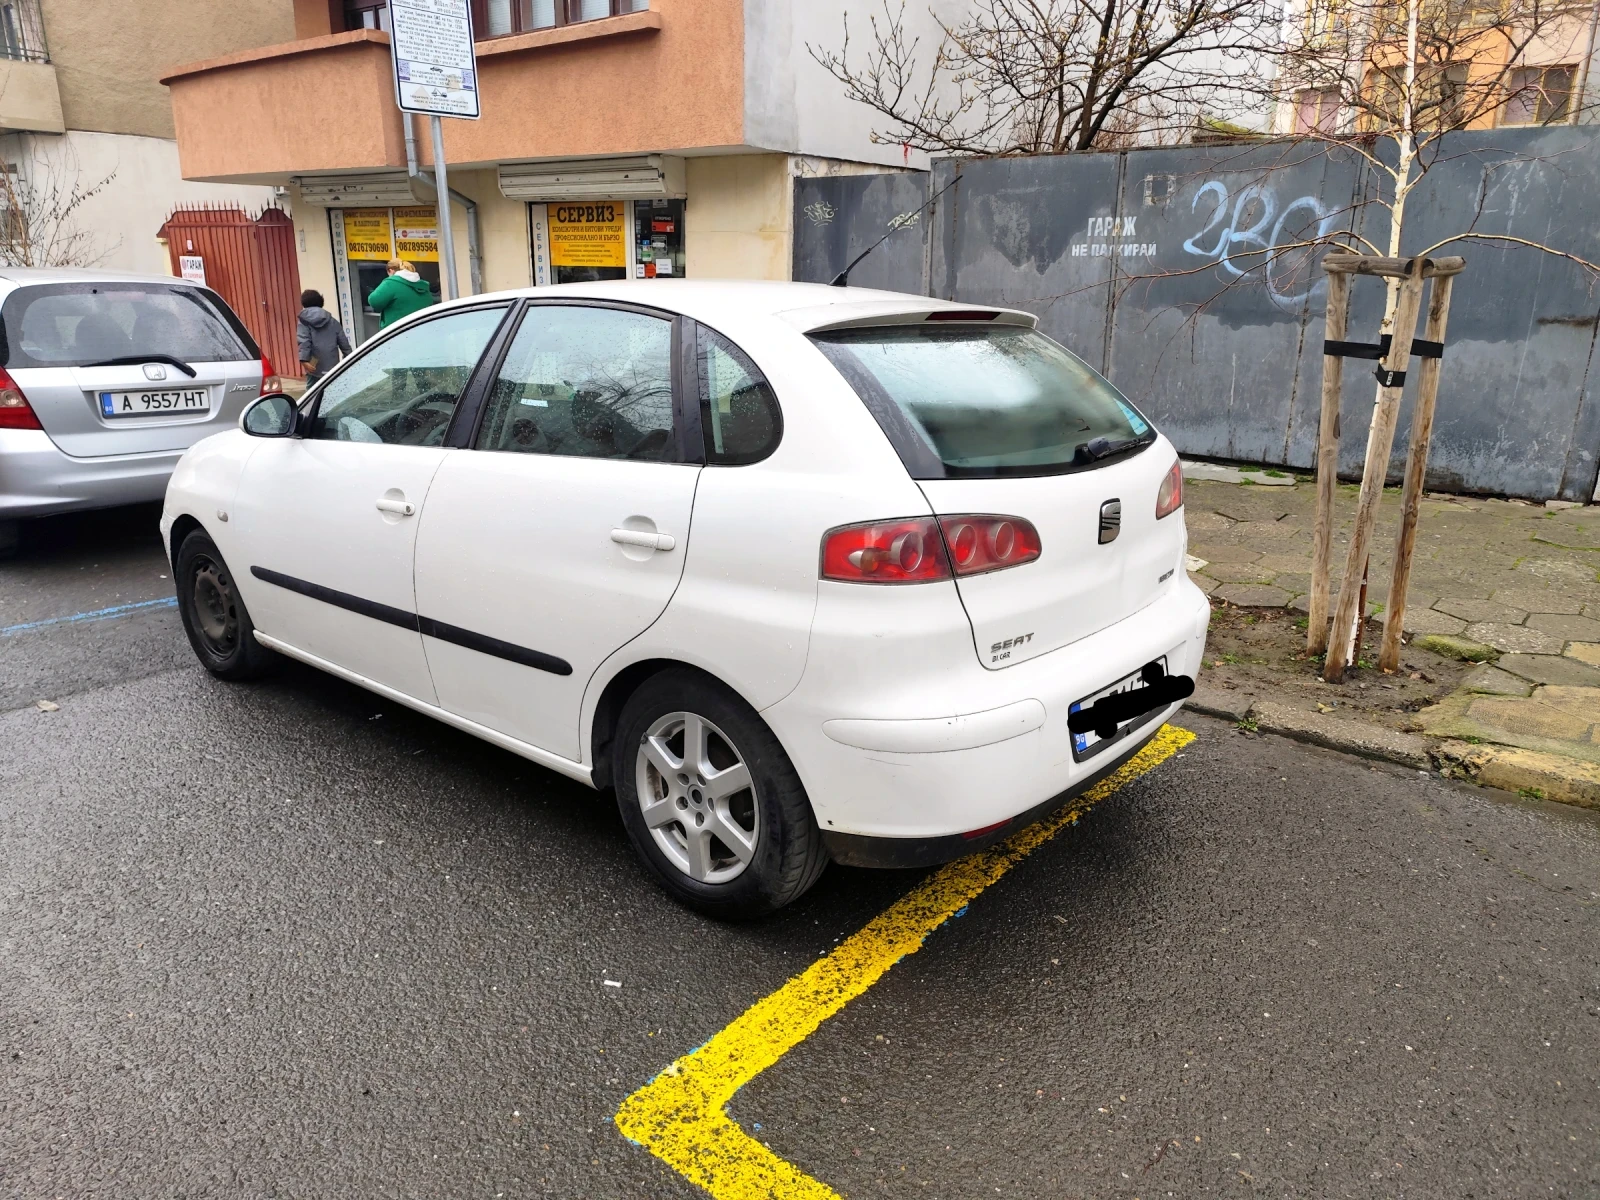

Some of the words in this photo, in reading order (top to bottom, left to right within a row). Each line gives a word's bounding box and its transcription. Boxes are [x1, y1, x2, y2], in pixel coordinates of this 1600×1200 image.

[557, 205, 615, 223] СЕРВИЗ
[585, 225, 604, 233] БИТОВИ
[605, 225, 622, 233] УРЕДИ
[1087, 216, 1137, 236] ГАРАЖ
[335, 213, 345, 282] КОМПЮТРИ
[536, 222, 544, 284] СЕРВИЗ
[1071, 244, 1088, 257] НЕ
[122, 395, 133, 411] A
[141, 392, 181, 410] 9557
[184, 391, 205, 407] HT
[991, 632, 1035, 653] SEAT
